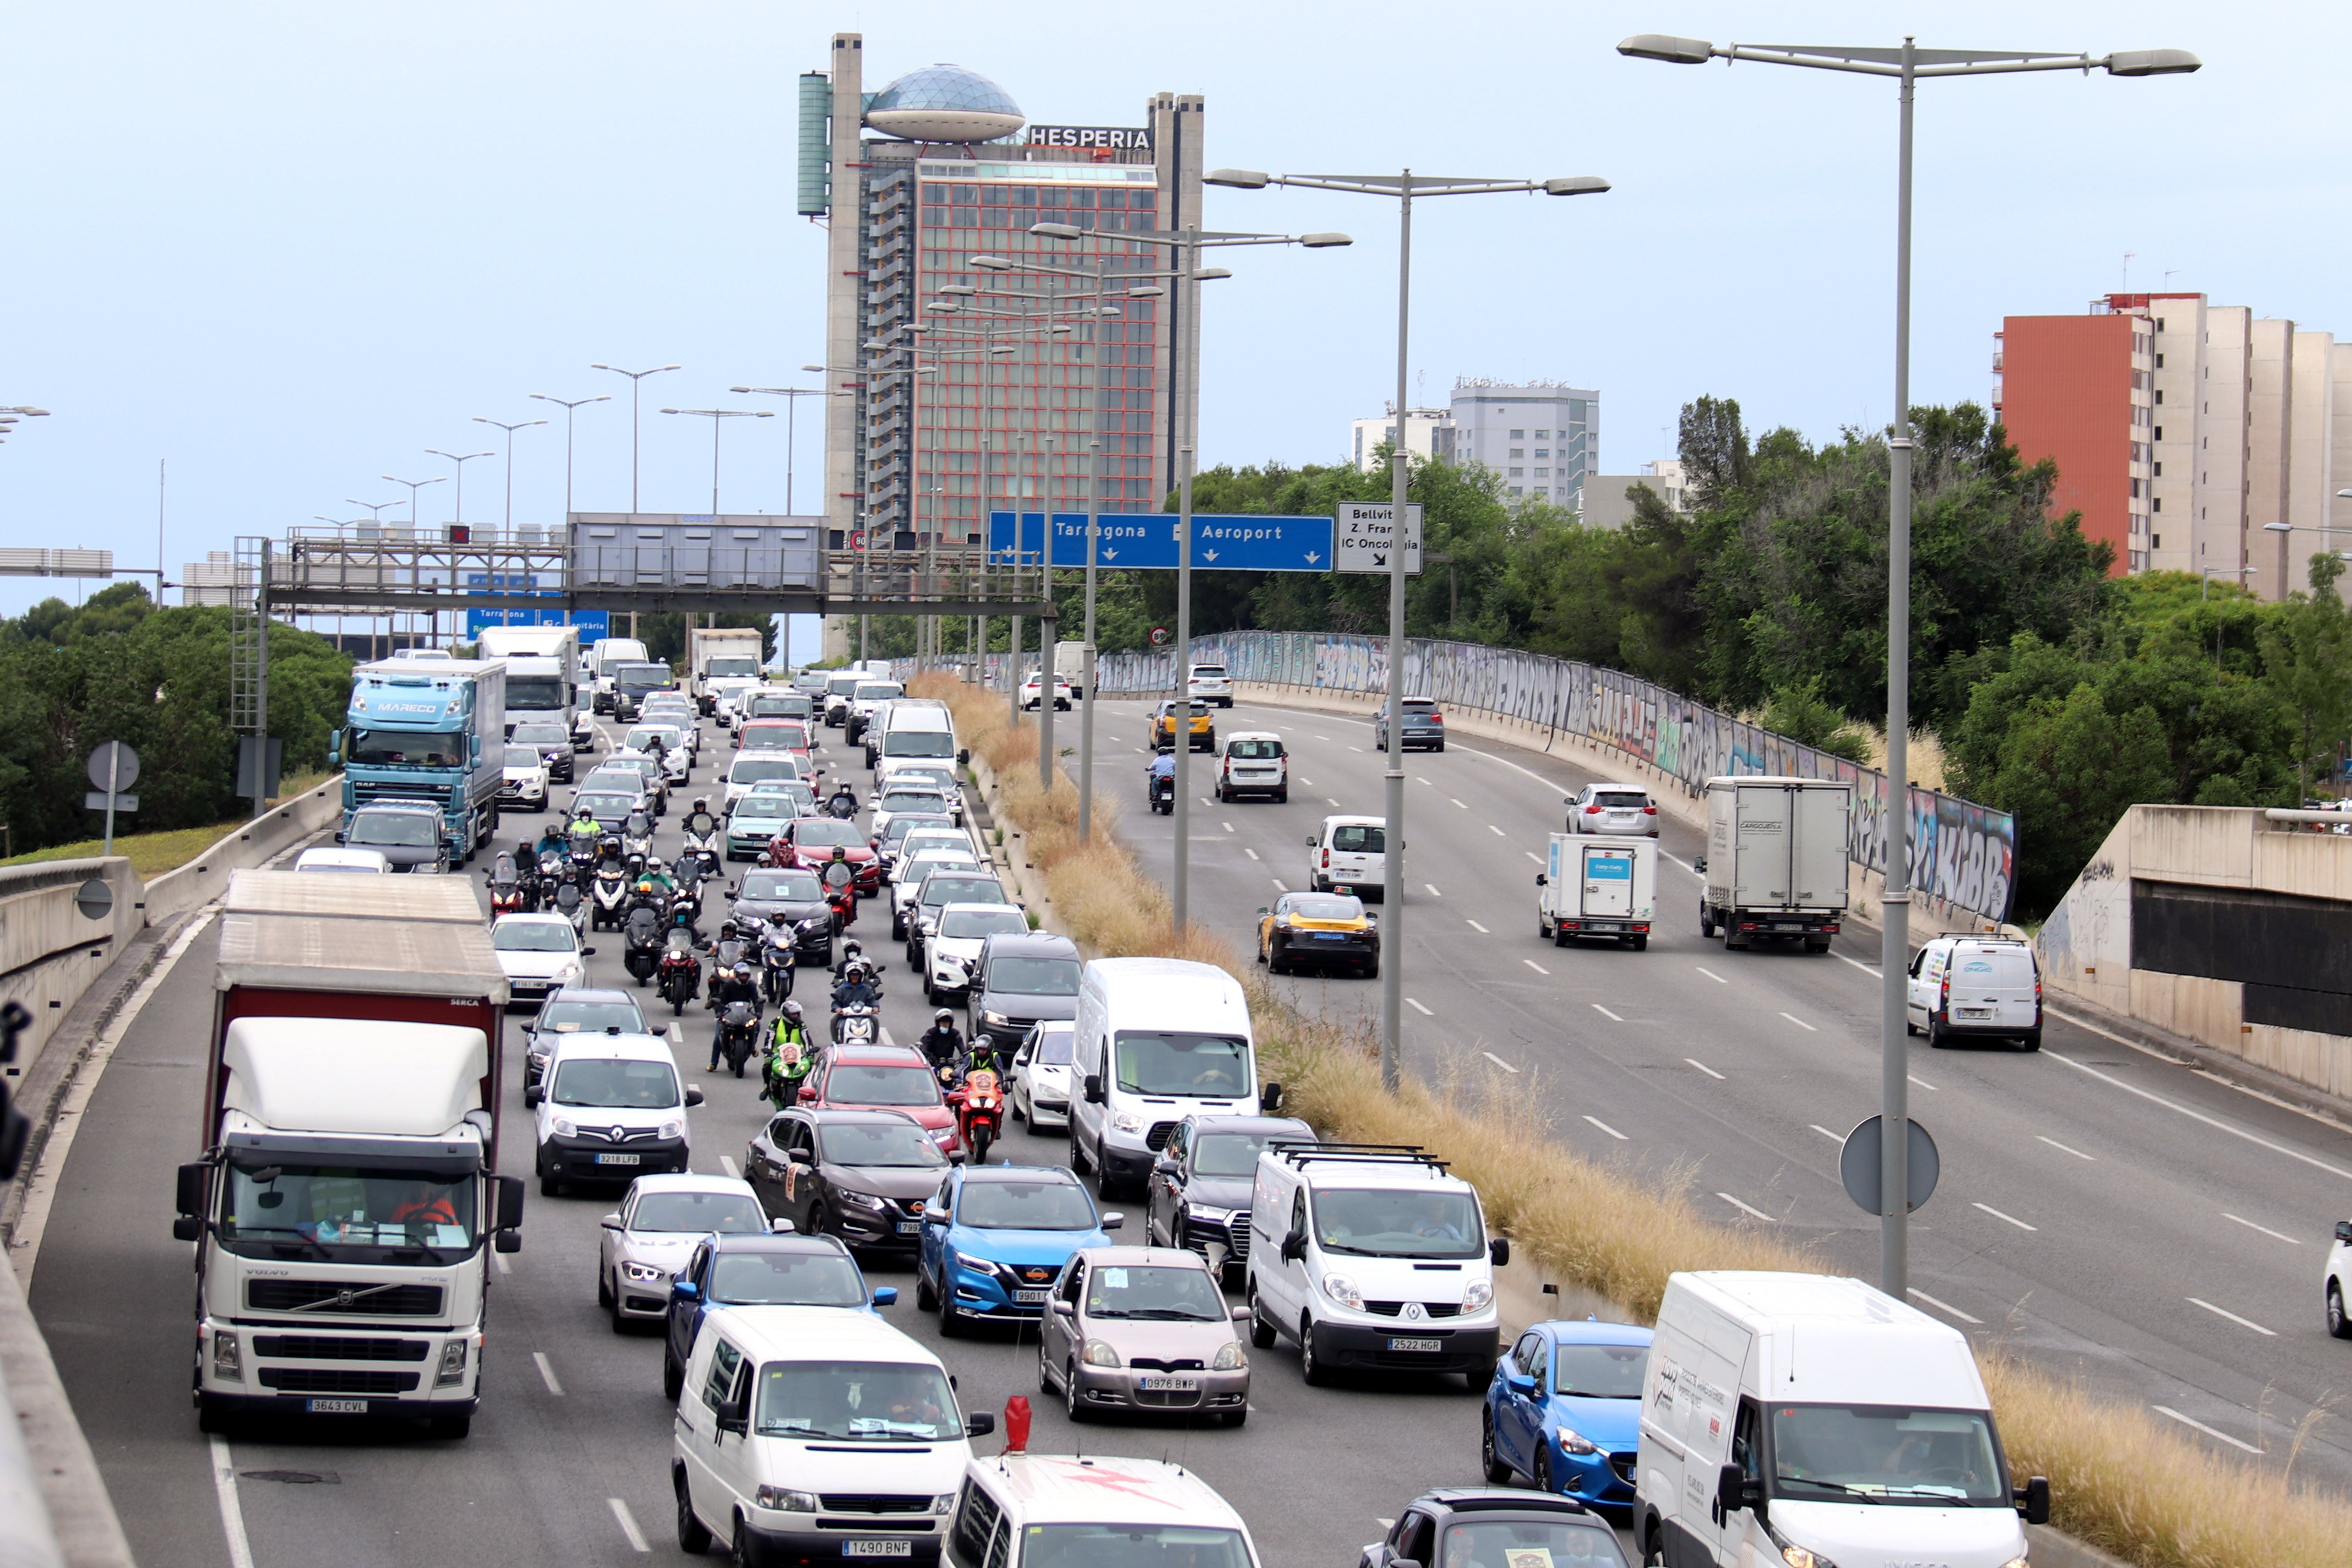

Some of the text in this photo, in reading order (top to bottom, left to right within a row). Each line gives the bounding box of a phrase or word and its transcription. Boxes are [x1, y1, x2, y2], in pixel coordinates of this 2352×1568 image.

[1031, 128, 1150, 148] HESPERIA
[1353, 509, 1407, 519] Bellvit
[1201, 525, 1282, 542] Aeroport
[1351, 524, 1408, 533] Z. Fran
[1342, 538, 1418, 551] IC Oncolia
[480, 609, 525, 618] Tarraona
[568, 622, 604, 630] anitària
[378, 703, 437, 714] MARECO
[1018, 1292, 1041, 1300] 9901
[1393, 1340, 1439, 1350] 2522 HGR
[1147, 1379, 1172, 1388] 0976
[314, 1400, 364, 1412] 3643 CVL
[853, 1542, 909, 1554] 1490 BNF
